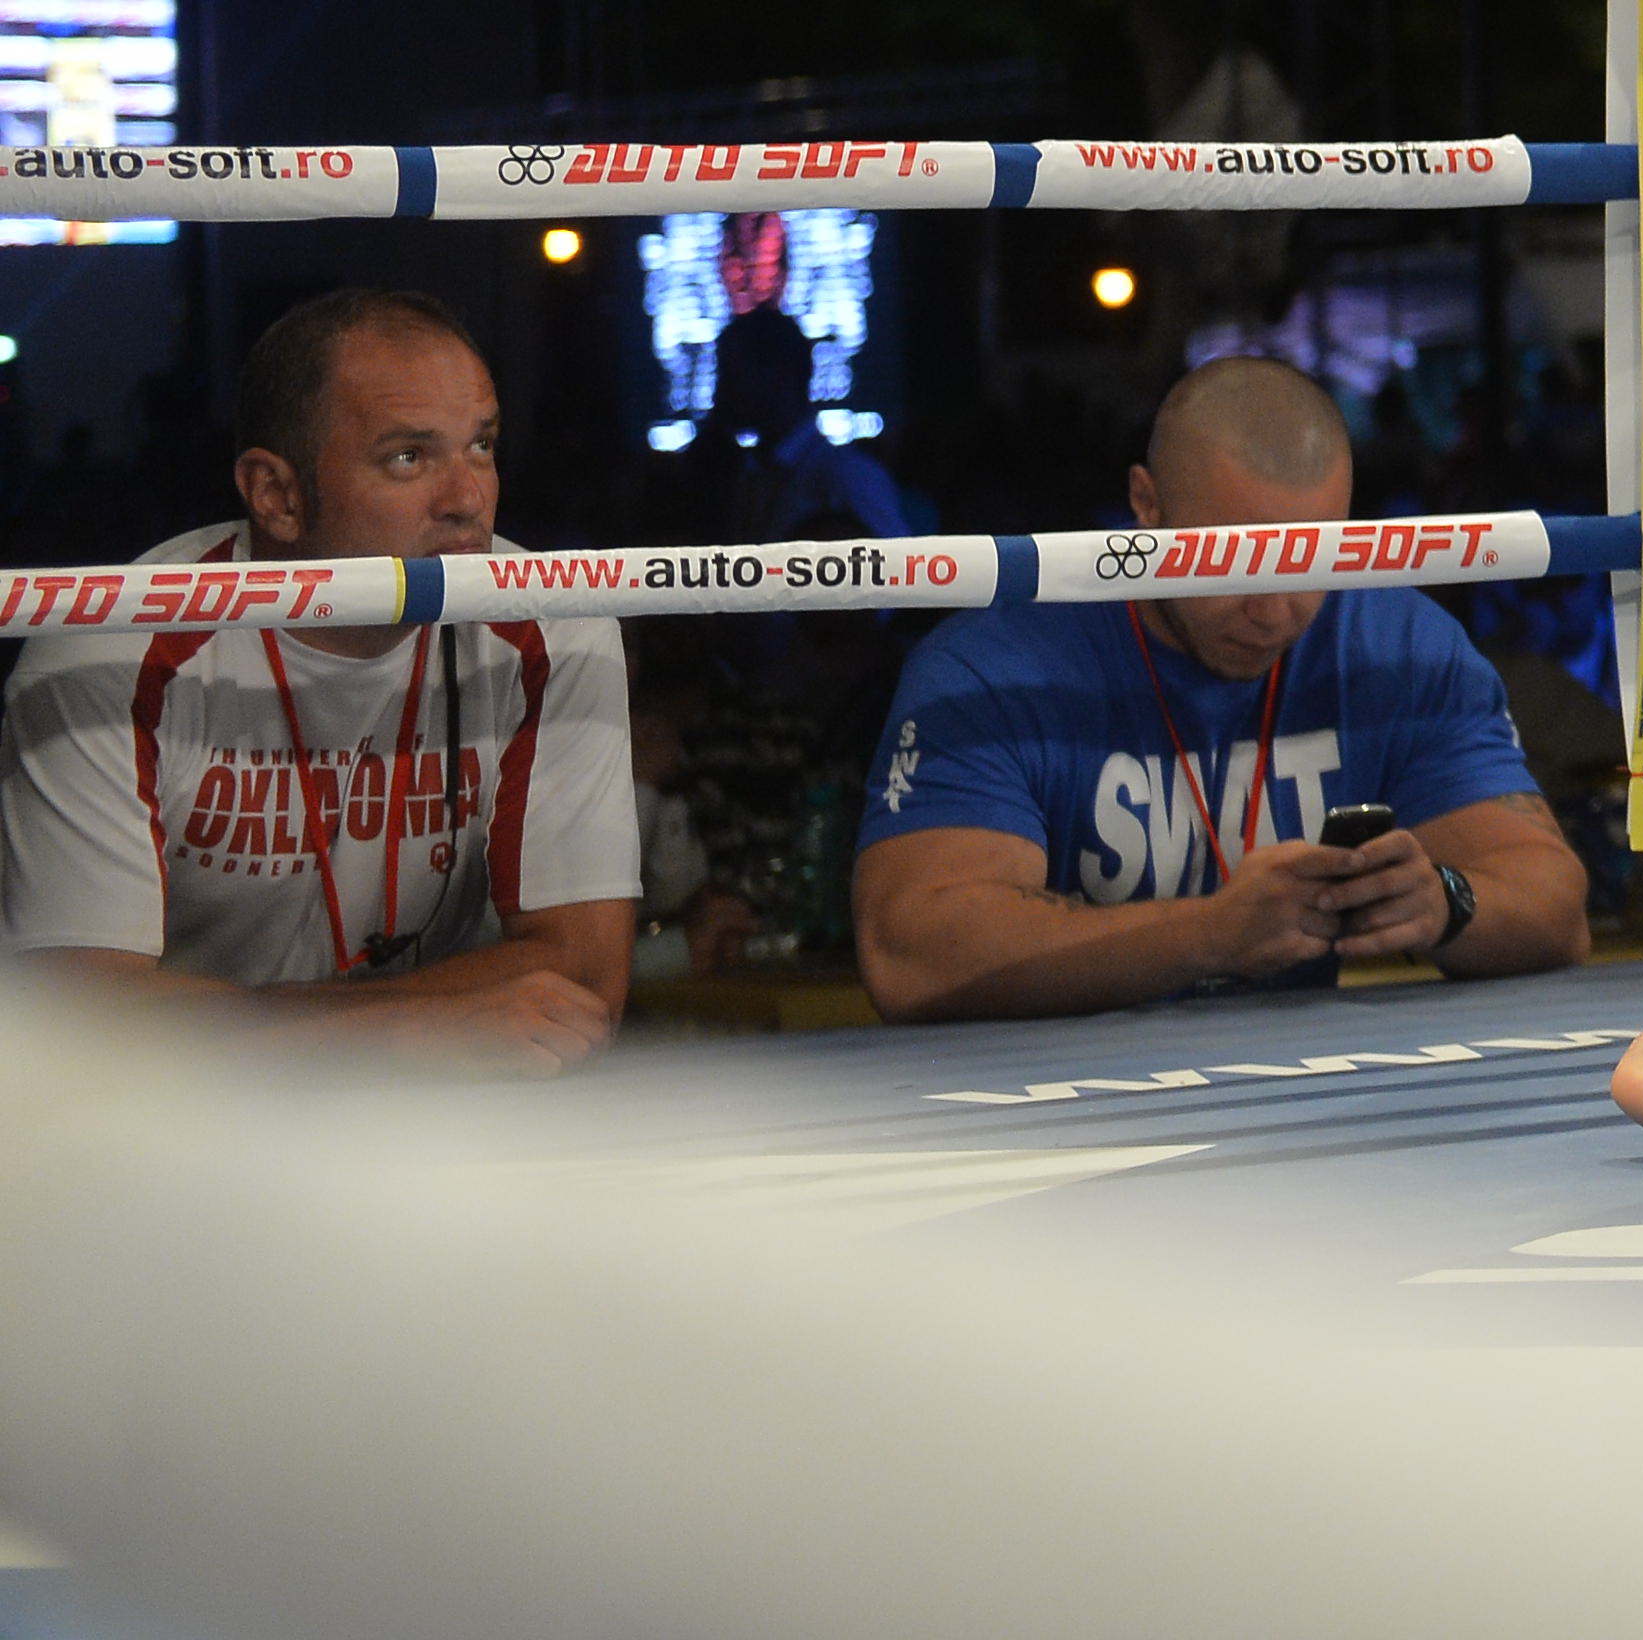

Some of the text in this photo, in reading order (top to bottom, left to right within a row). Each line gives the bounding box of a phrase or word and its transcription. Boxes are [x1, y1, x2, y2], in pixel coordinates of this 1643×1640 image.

[563, 140, 920, 185] AUTO SOFT
[487, 546, 958, 592] www.auto-soft.ro
[1155, 522, 1494, 579] AUTO SOFT
[134, 568, 334, 622] SOFT
[1079, 728, 1341, 905] SWAT
